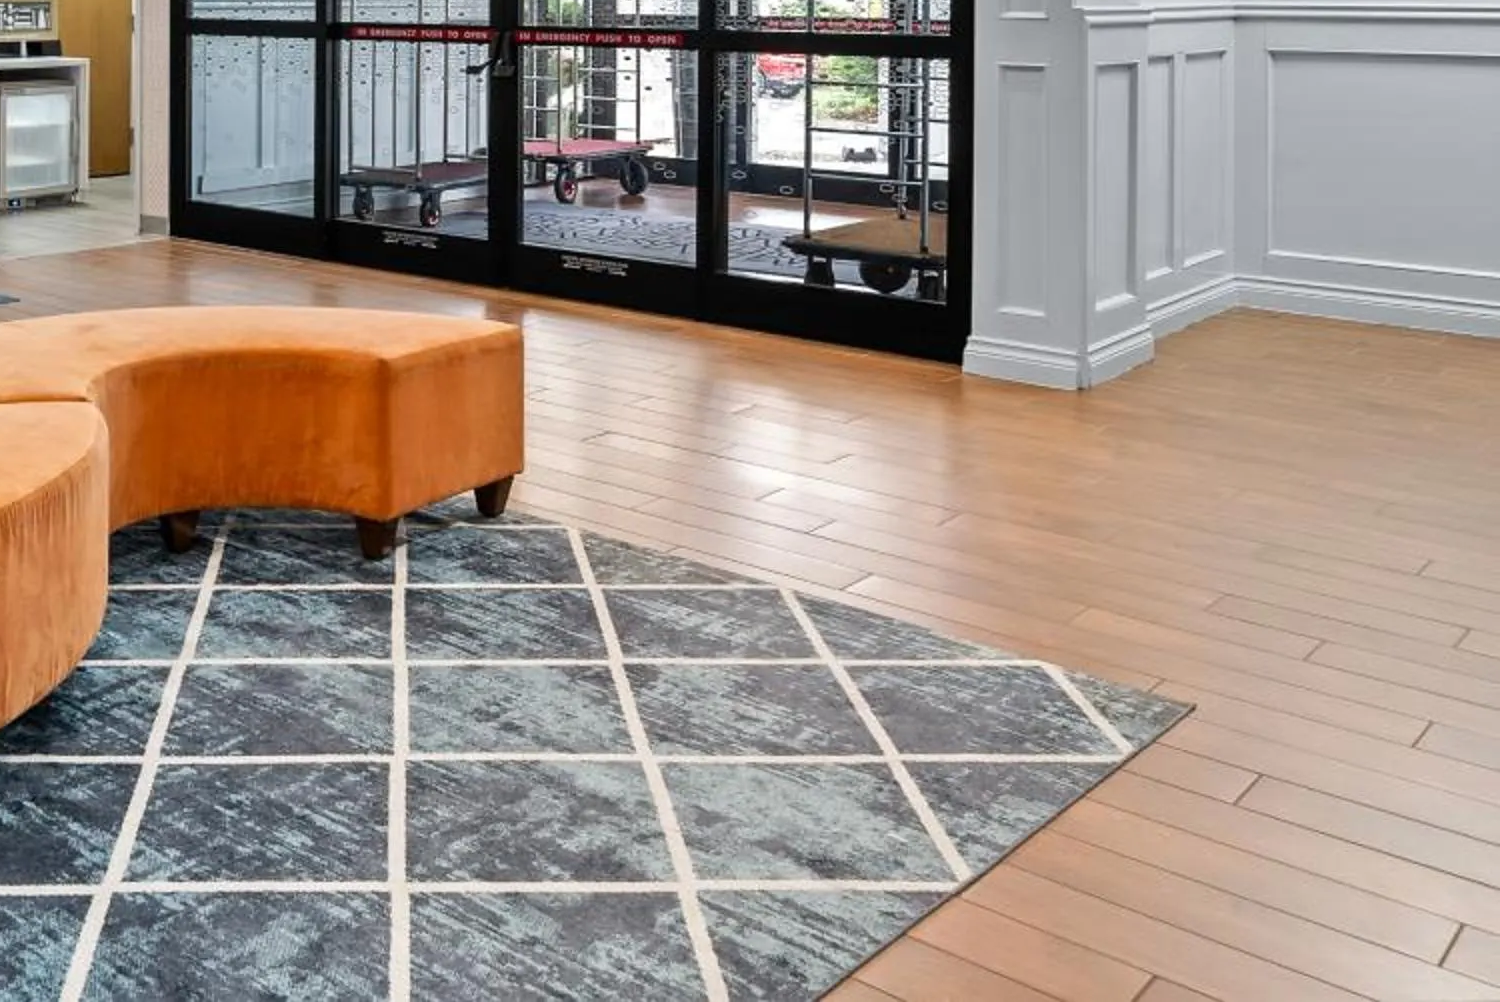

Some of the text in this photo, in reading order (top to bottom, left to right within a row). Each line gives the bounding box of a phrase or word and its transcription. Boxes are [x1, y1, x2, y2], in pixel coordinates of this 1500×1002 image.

[518, 30, 678, 46] IN EMERGENCY PUSH TO OPEN
